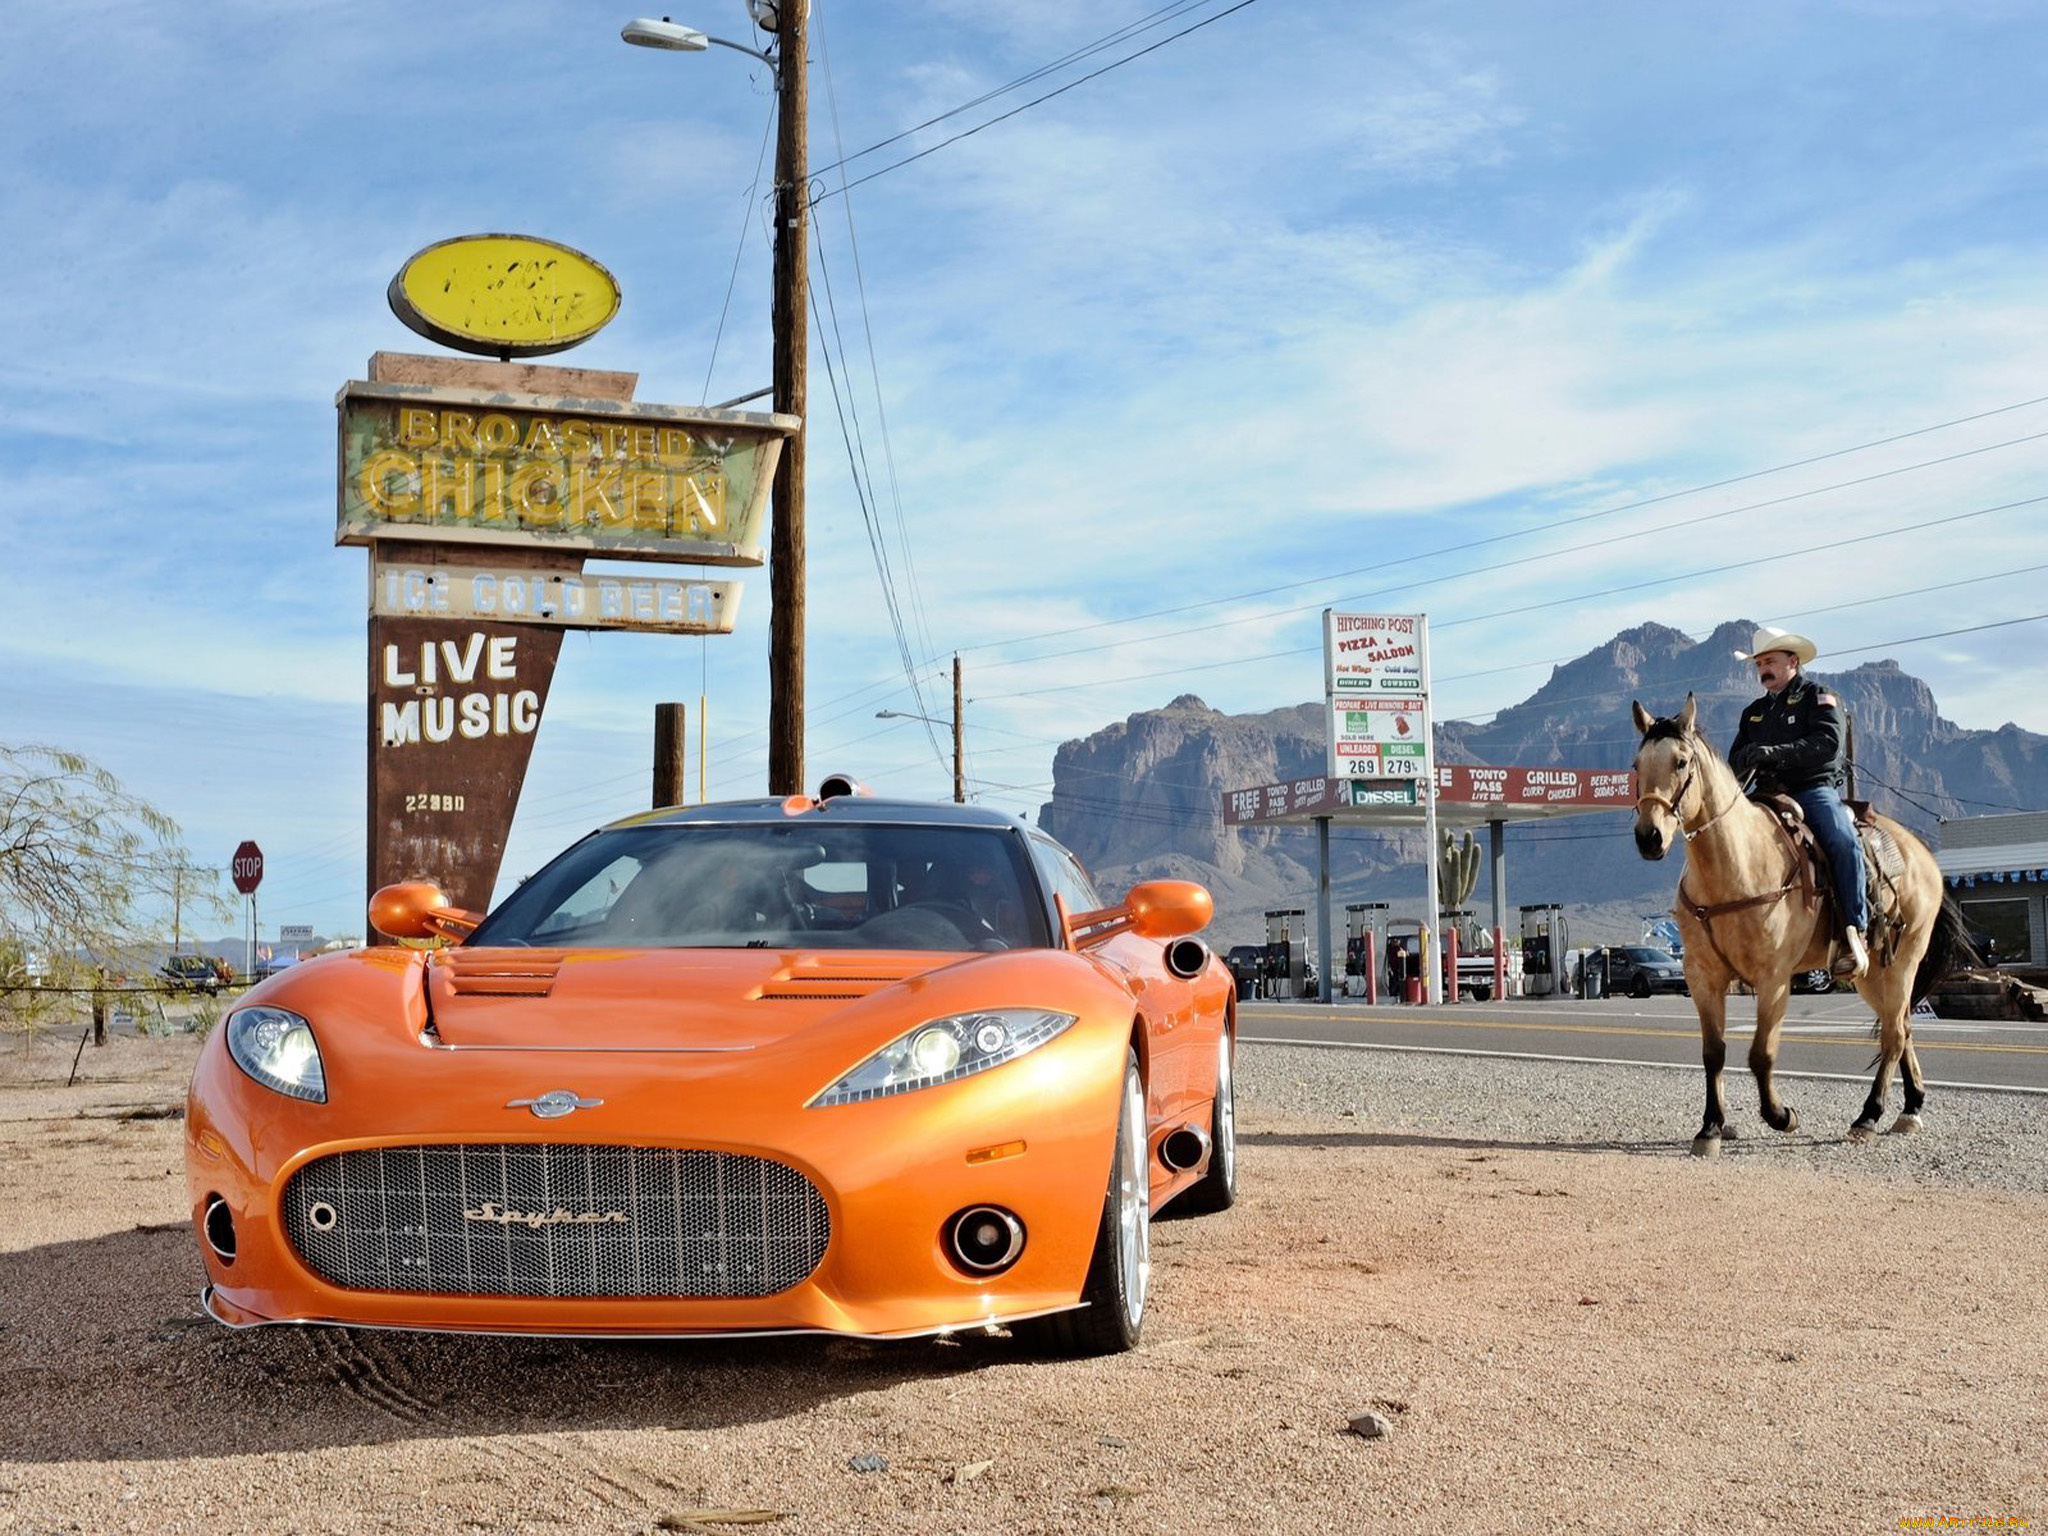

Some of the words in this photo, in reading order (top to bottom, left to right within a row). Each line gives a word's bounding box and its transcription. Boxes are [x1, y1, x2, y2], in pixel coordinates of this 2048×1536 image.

[401, 407, 693, 466] BROASTED
[360, 452, 728, 533] CHICKEN
[385, 570, 449, 611] ICE
[472, 574, 586, 617] COLD
[598, 580, 713, 622] BEER
[1337, 616, 1385, 633] HITCHING
[1388, 618, 1414, 634] POST
[1338, 636, 1378, 652] PIZZA
[383, 632, 518, 687] LIVE
[1367, 645, 1415, 662] SALOON
[380, 690, 539, 747] MUSIC
[1339, 744, 1377, 754] UNLEADED
[1391, 745, 1415, 754] DIESEL
[1349, 760, 1375, 774] 269
[1387, 760, 1411, 774] 279
[1468, 769, 1508, 780] TONTO
[1294, 778, 1326, 795] GRILLED
[1473, 780, 1503, 792] PASS
[1527, 770, 1577, 786] GRILLED
[1266, 784, 1288, 797] TONTO
[1356, 790, 1414, 804] DIESEL
[1231, 790, 1260, 812] FREE
[234, 857, 262, 878] STOP
[463, 1202, 632, 1229] Spyker
